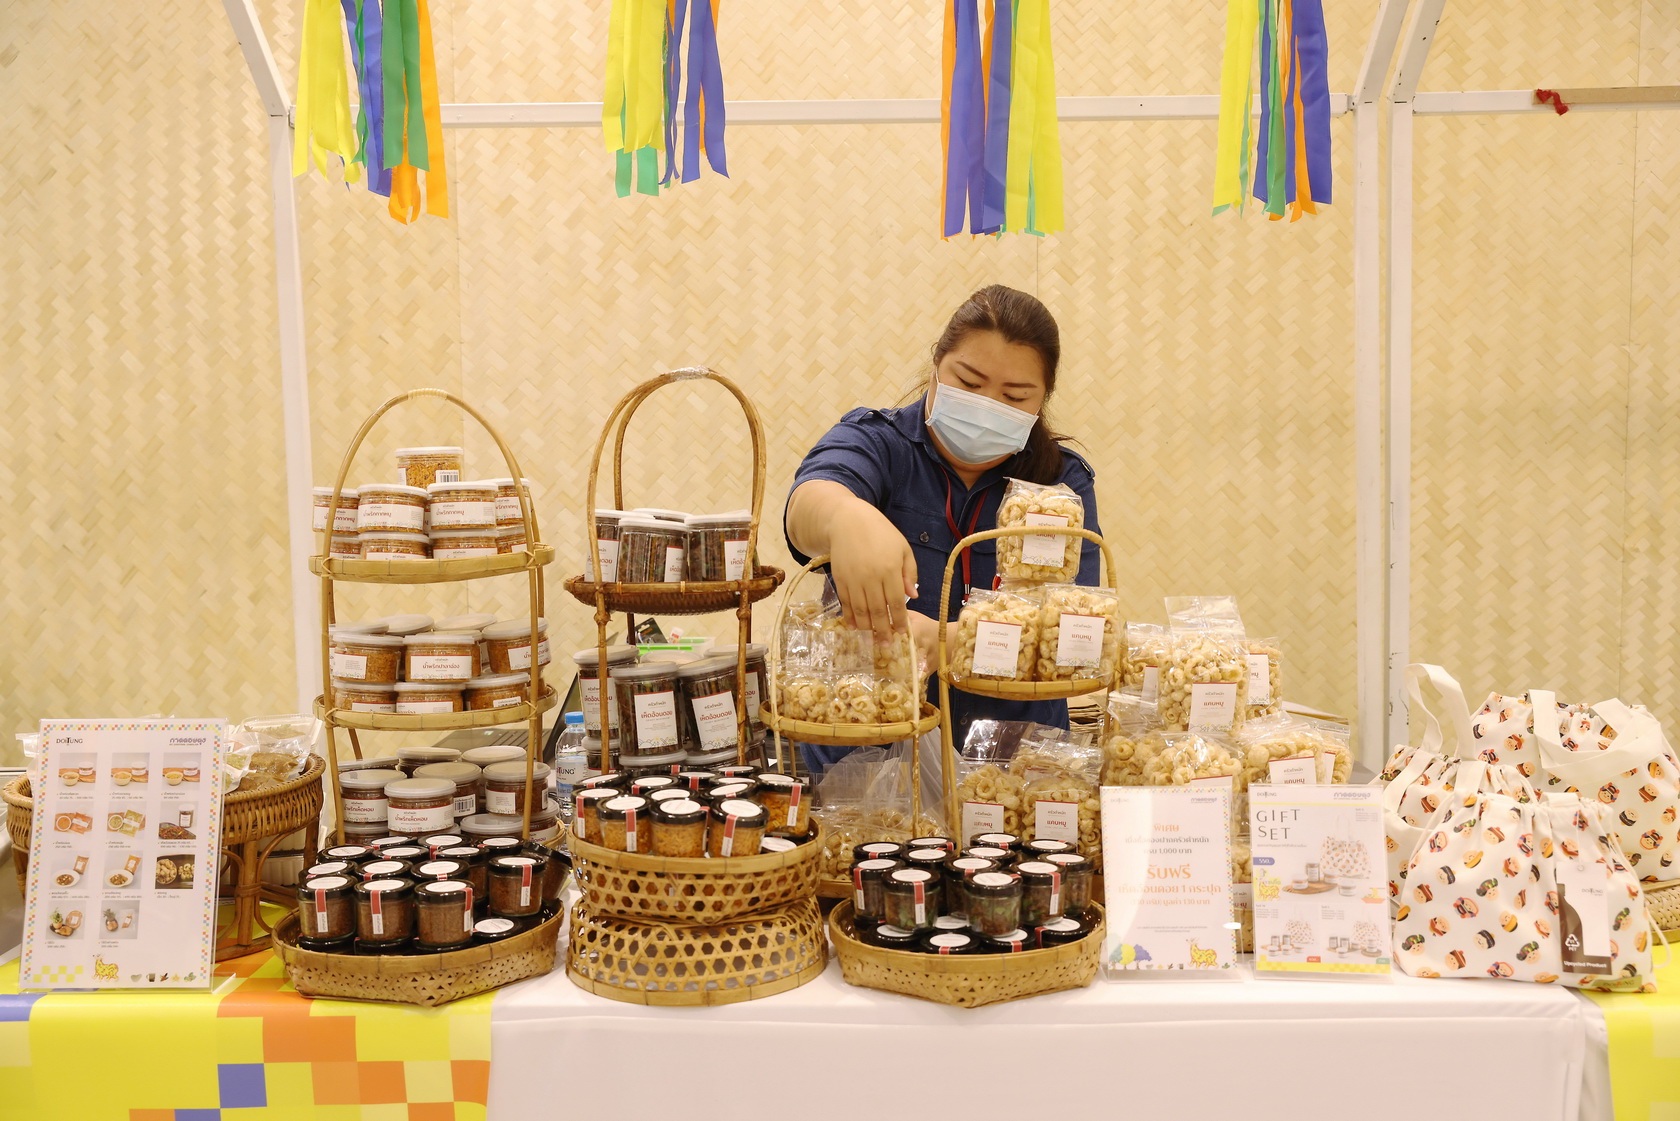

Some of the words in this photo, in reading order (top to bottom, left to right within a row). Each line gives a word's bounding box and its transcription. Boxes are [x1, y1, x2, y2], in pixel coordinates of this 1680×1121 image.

[1071, 633, 1092, 641] แคบหมู
[988, 640, 1008, 648] แคบหมู
[1203, 700, 1224, 708] แคบหมู
[640, 710, 673, 719] เห็ดอ้อนดอย
[699, 710, 733, 721] เห็ดอ้อนดอย
[1256, 808, 1301, 823] GIFT
[1153, 823, 1180, 833] พิเศษ
[1257, 825, 1291, 841] SET
[1158, 847, 1177, 855] 1,000
[1147, 863, 1191, 879] รับฟรี
[1189, 884, 1221, 896] กระปุก
